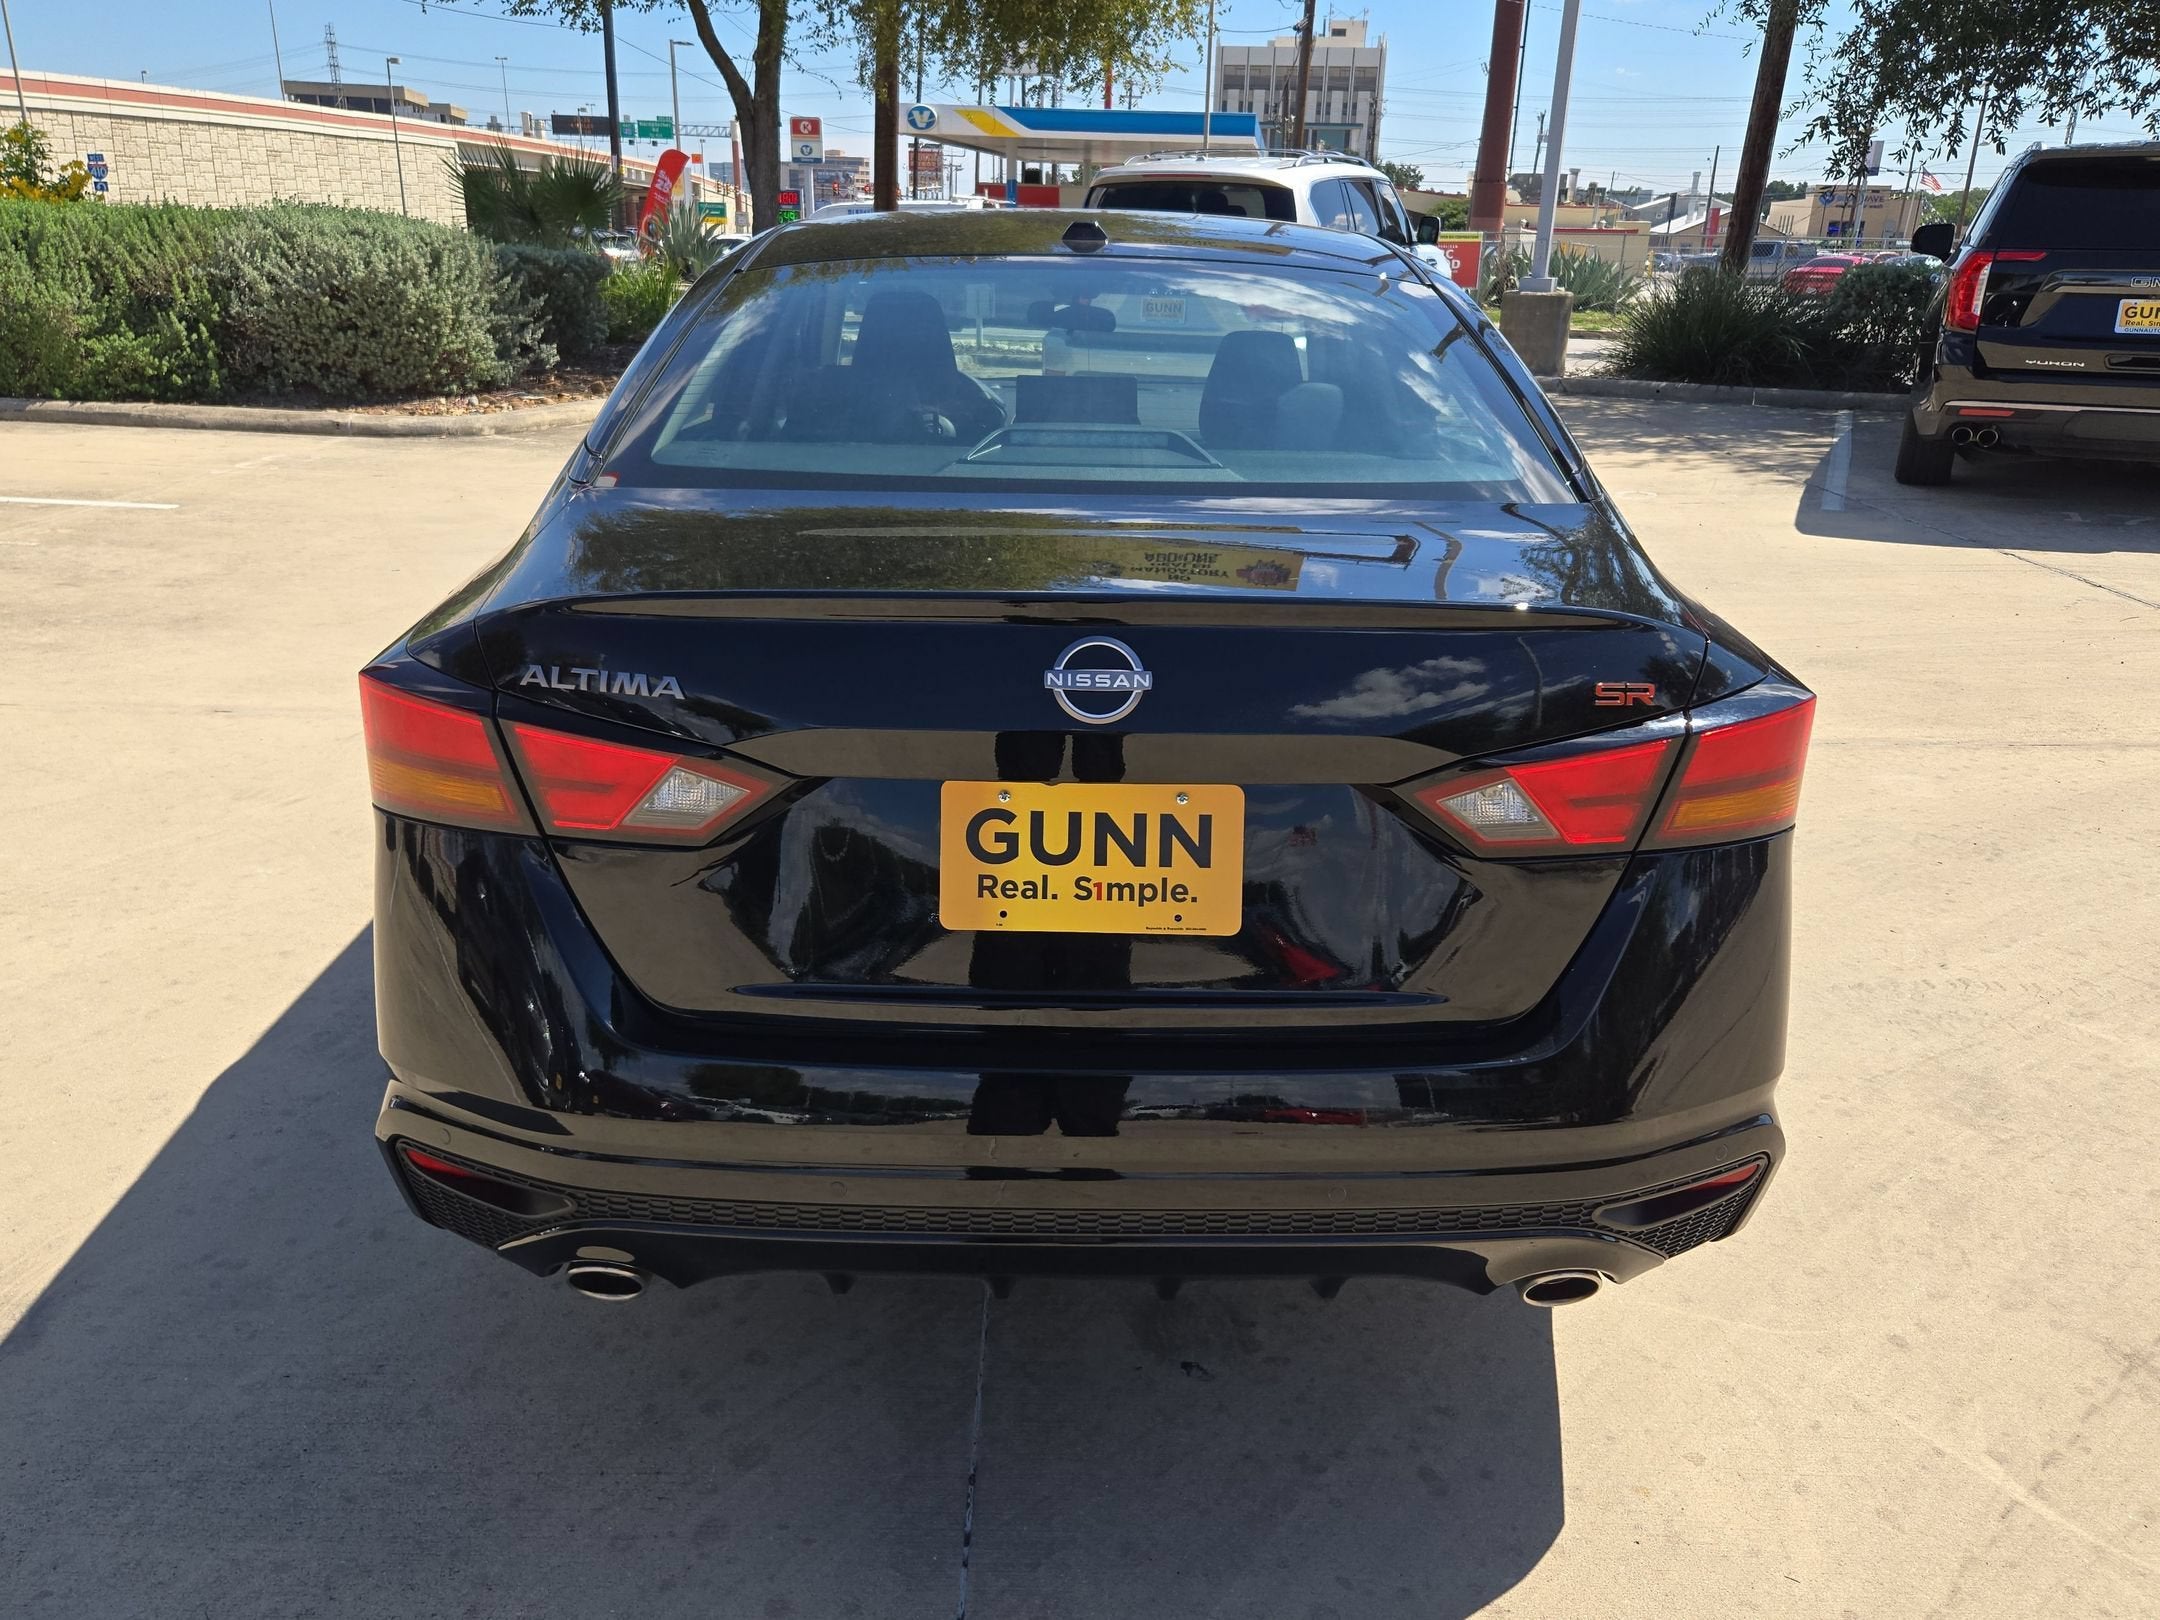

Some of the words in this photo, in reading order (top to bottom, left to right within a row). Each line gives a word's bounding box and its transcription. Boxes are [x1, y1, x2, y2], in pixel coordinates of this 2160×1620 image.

[91, 166, 107, 178] 410
[1146, 303, 1182, 313] GUNN
[520, 664, 686, 700] ALTIMA
[1047, 672, 1149, 688] NISSAN
[1595, 682, 1656, 706] SR
[965, 807, 1213, 869] GUNN
[977, 874, 1058, 900] Real.
